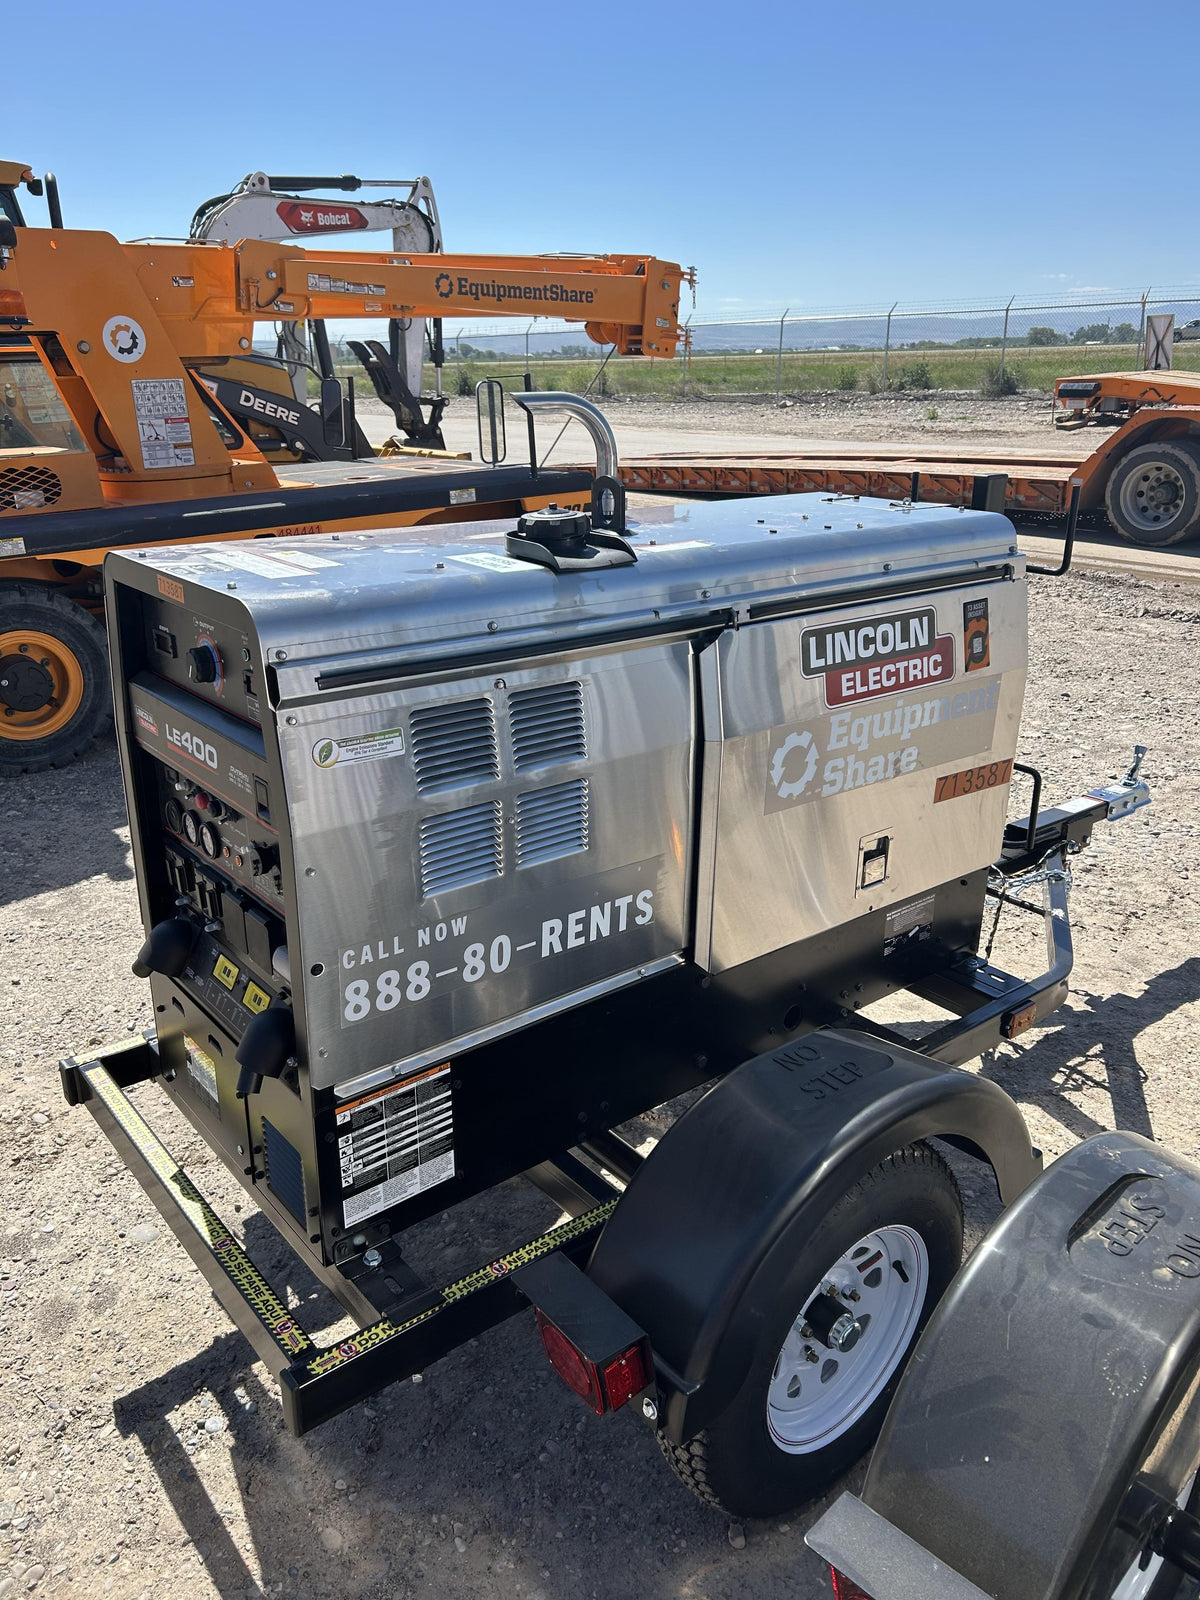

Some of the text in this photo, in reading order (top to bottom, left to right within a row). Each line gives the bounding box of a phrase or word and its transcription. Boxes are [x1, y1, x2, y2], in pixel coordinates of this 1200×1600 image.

[317, 212, 350, 226] Bobcat
[457, 277, 594, 303] EquipmentShare
[239, 390, 300, 425] DEERE
[278, 525, 321, 537] 484441
[809, 616, 929, 669] LINCOLN
[841, 653, 942, 697] ELECTRIC
[827, 680, 1001, 752] Equipment
[165, 723, 218, 770] LE400
[822, 745, 918, 797] Share
[938, 760, 1011, 801] 713587
[342, 916, 468, 969] CALL NOW
[344, 889, 654, 1022] 888-80-RENTS
[772, 1046, 820, 1072] NO
[800, 1062, 863, 1099] STEP
[109, 1093, 121, 1108] NOT
[120, 1105, 138, 1128] STAND
[135, 1124, 152, 1144] HERE
[208, 1227, 222, 1240] ICI
[507, 1254, 525, 1267] NE
[526, 1241, 550, 1257] PAS
[549, 1222, 590, 1244] TENEZ
[1099, 1193, 1166, 1257] STEP
[225, 1249, 286, 1322] NO SE PARE AQUÍ
[459, 1272, 493, 1293] HERE
[358, 1332, 380, 1347] DO
